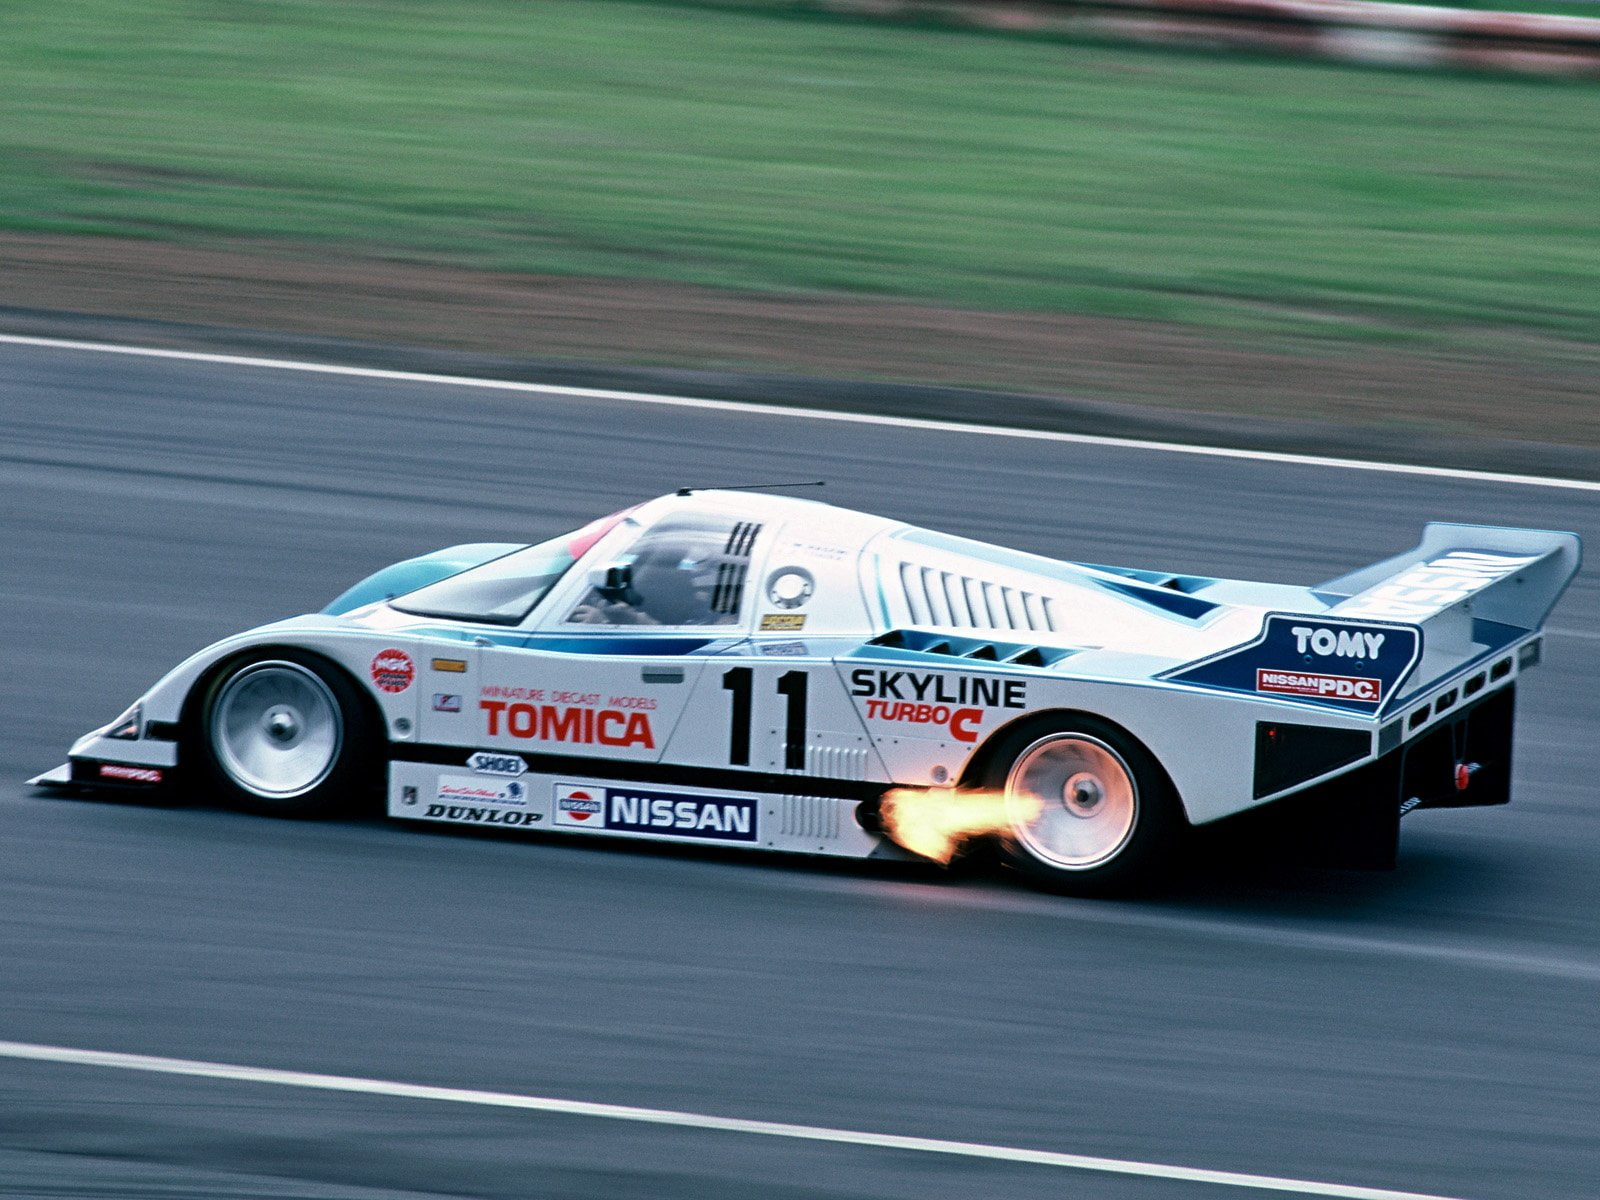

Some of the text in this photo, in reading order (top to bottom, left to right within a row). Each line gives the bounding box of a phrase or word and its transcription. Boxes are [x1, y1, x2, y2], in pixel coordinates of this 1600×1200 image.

[1291, 626, 1385, 660] TOMY
[851, 668, 1026, 709] SKYLINE
[1262, 673, 1319, 688] NISSAN
[608, 696, 658, 711] MODELS
[722, 666, 809, 770] 11
[479, 700, 656, 750] TOMICA
[865, 700, 984, 743] TURBO C
[475, 755, 520, 773] SHOEI
[424, 804, 544, 826] DUNLOP
[559, 799, 601, 813] NISSAN
[611, 796, 750, 834] NISSAN
